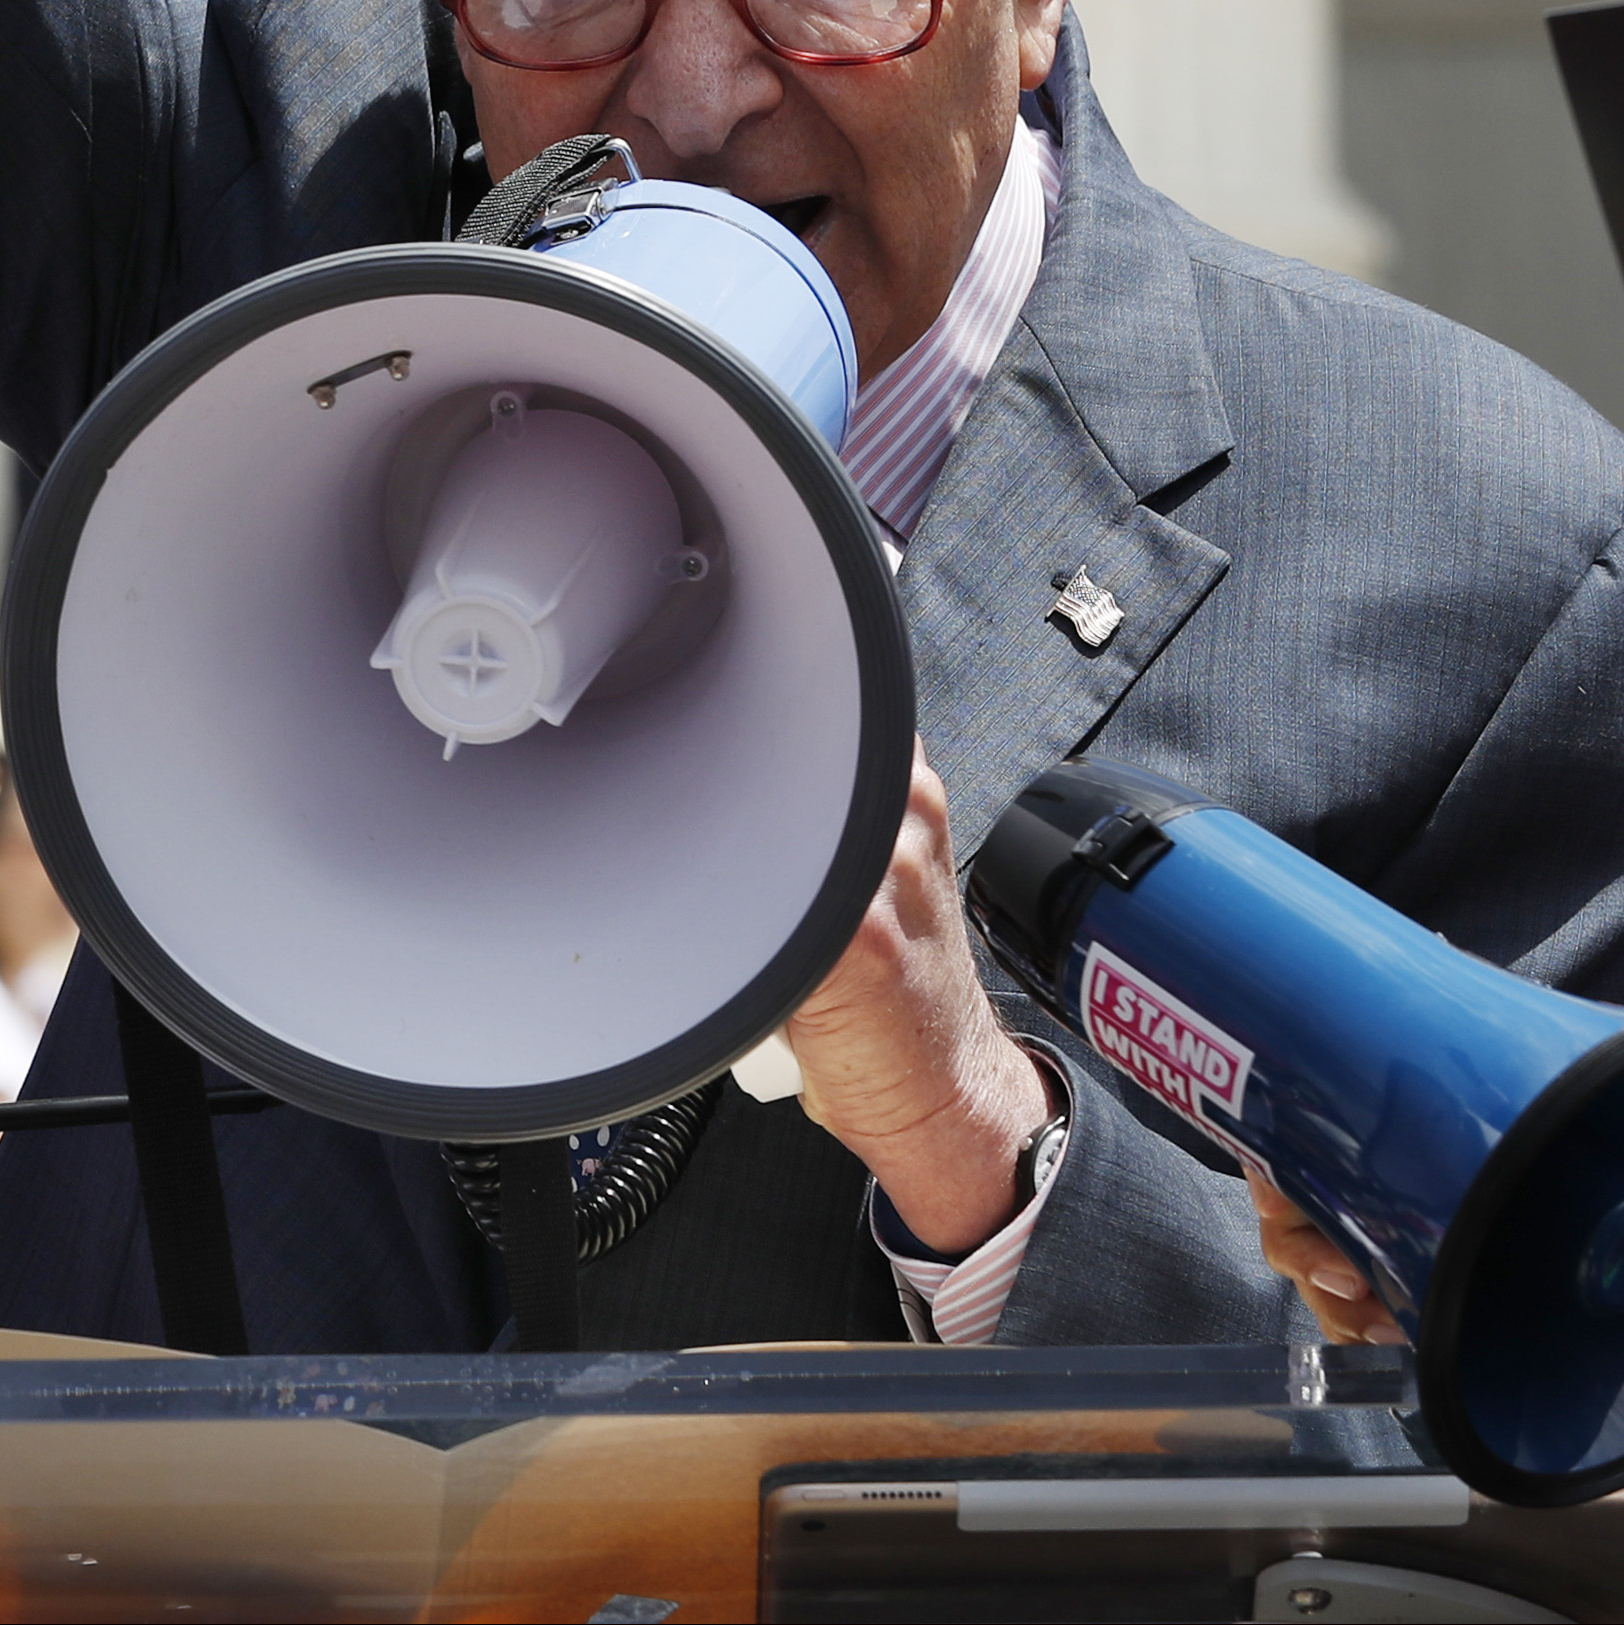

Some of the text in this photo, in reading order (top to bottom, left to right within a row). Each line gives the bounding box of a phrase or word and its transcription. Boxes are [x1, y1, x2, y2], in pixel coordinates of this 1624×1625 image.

[1093, 968, 1232, 1089] I STAND
[1093, 1015, 1190, 1104] WITH
